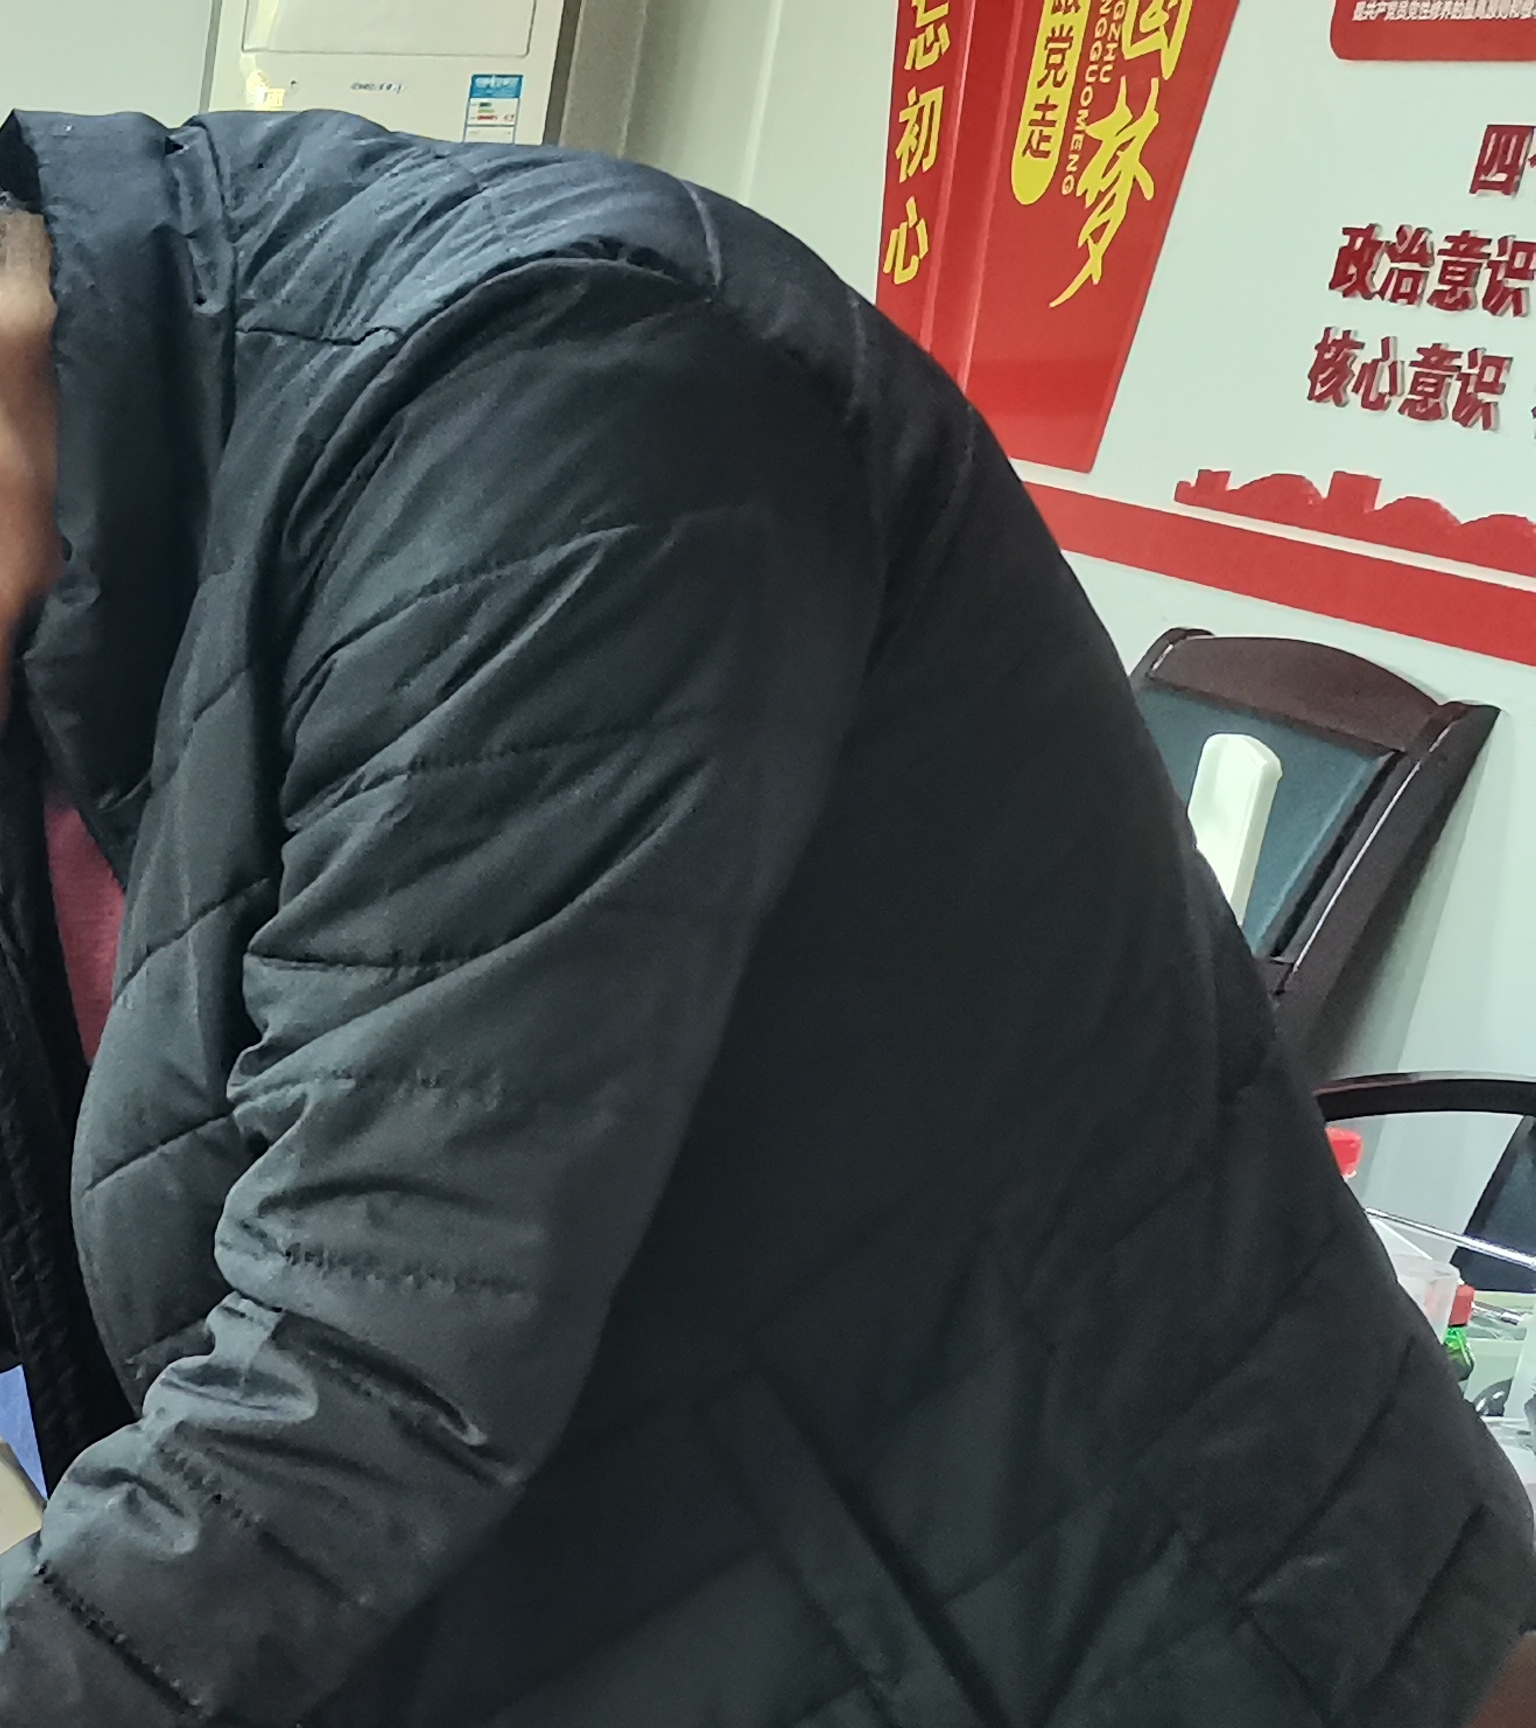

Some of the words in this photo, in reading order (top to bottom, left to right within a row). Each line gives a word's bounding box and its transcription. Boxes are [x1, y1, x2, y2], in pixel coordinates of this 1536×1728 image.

[883, 0, 950, 285] 忘初心
[1469, 124, 1536, 196] 四
[1328, 223, 1536, 317] 政治意识
[1307, 326, 1514, 432] 核心意识
